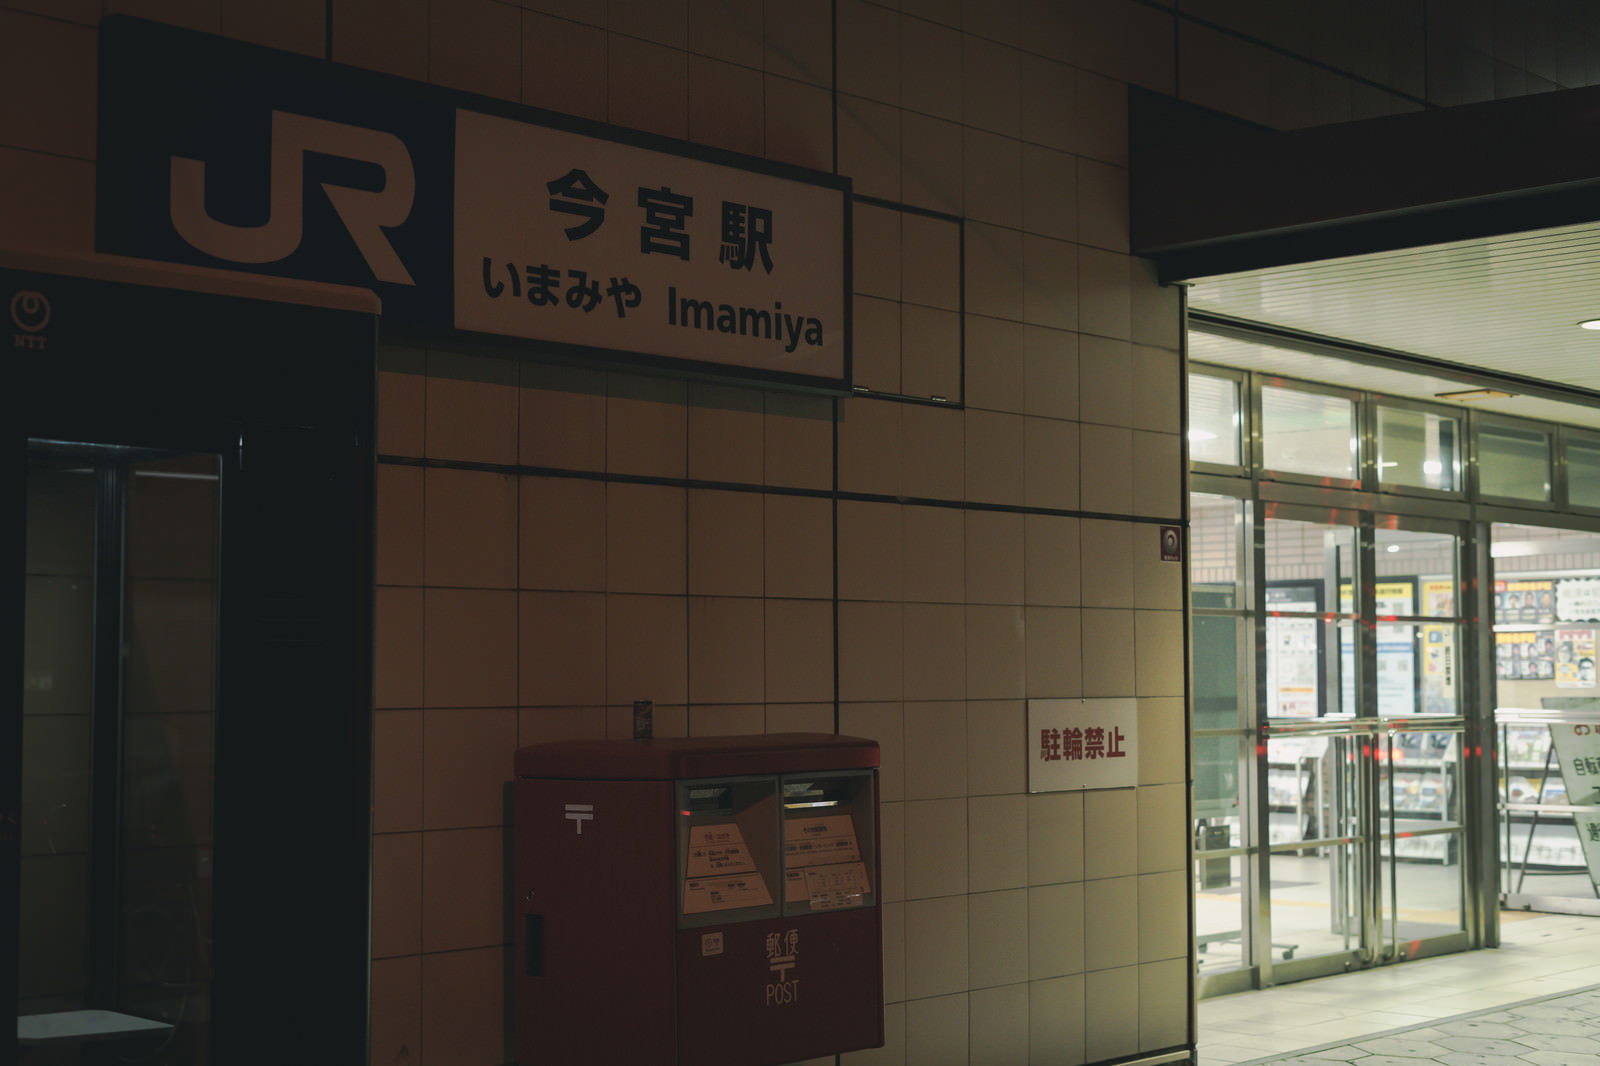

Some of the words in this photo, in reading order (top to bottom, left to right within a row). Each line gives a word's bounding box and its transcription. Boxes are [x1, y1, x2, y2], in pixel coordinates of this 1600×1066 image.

[170, 109, 417, 286] JR
[547, 168, 774, 275] 今宮駅
[483, 257, 642, 318] いまみや
[669, 286, 823, 353] Imamiya
[1040, 726, 1126, 762] 駐輪禁止
[765, 928, 800, 958] 郵便
[765, 979, 801, 1007] POST
